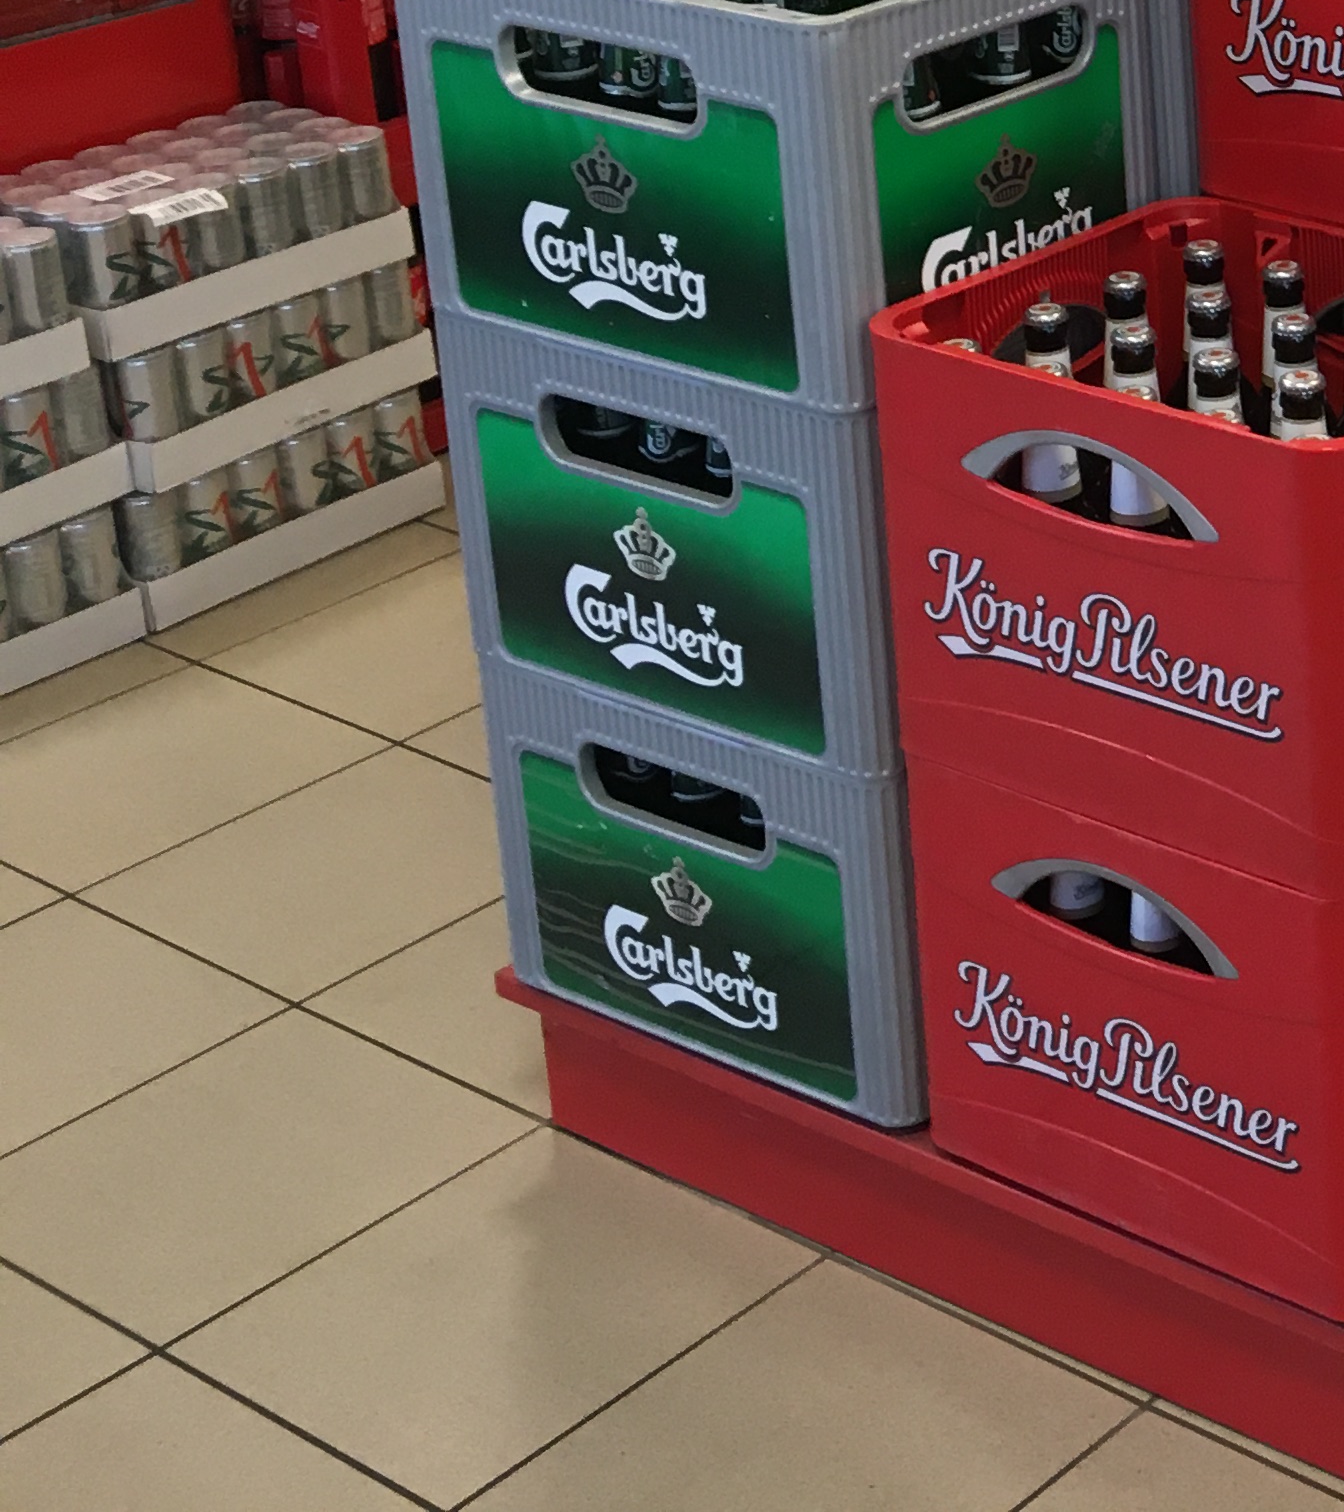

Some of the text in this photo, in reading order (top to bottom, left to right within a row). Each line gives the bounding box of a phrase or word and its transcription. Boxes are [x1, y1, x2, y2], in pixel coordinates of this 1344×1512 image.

[522, 200, 707, 321] Carlsberg
[564, 564, 744, 687] Carlsberg
[924, 548, 1282, 740] König Pilsener
[604, 905, 778, 1031] Carlsberg
[953, 960, 1300, 1171] König Pilsener
